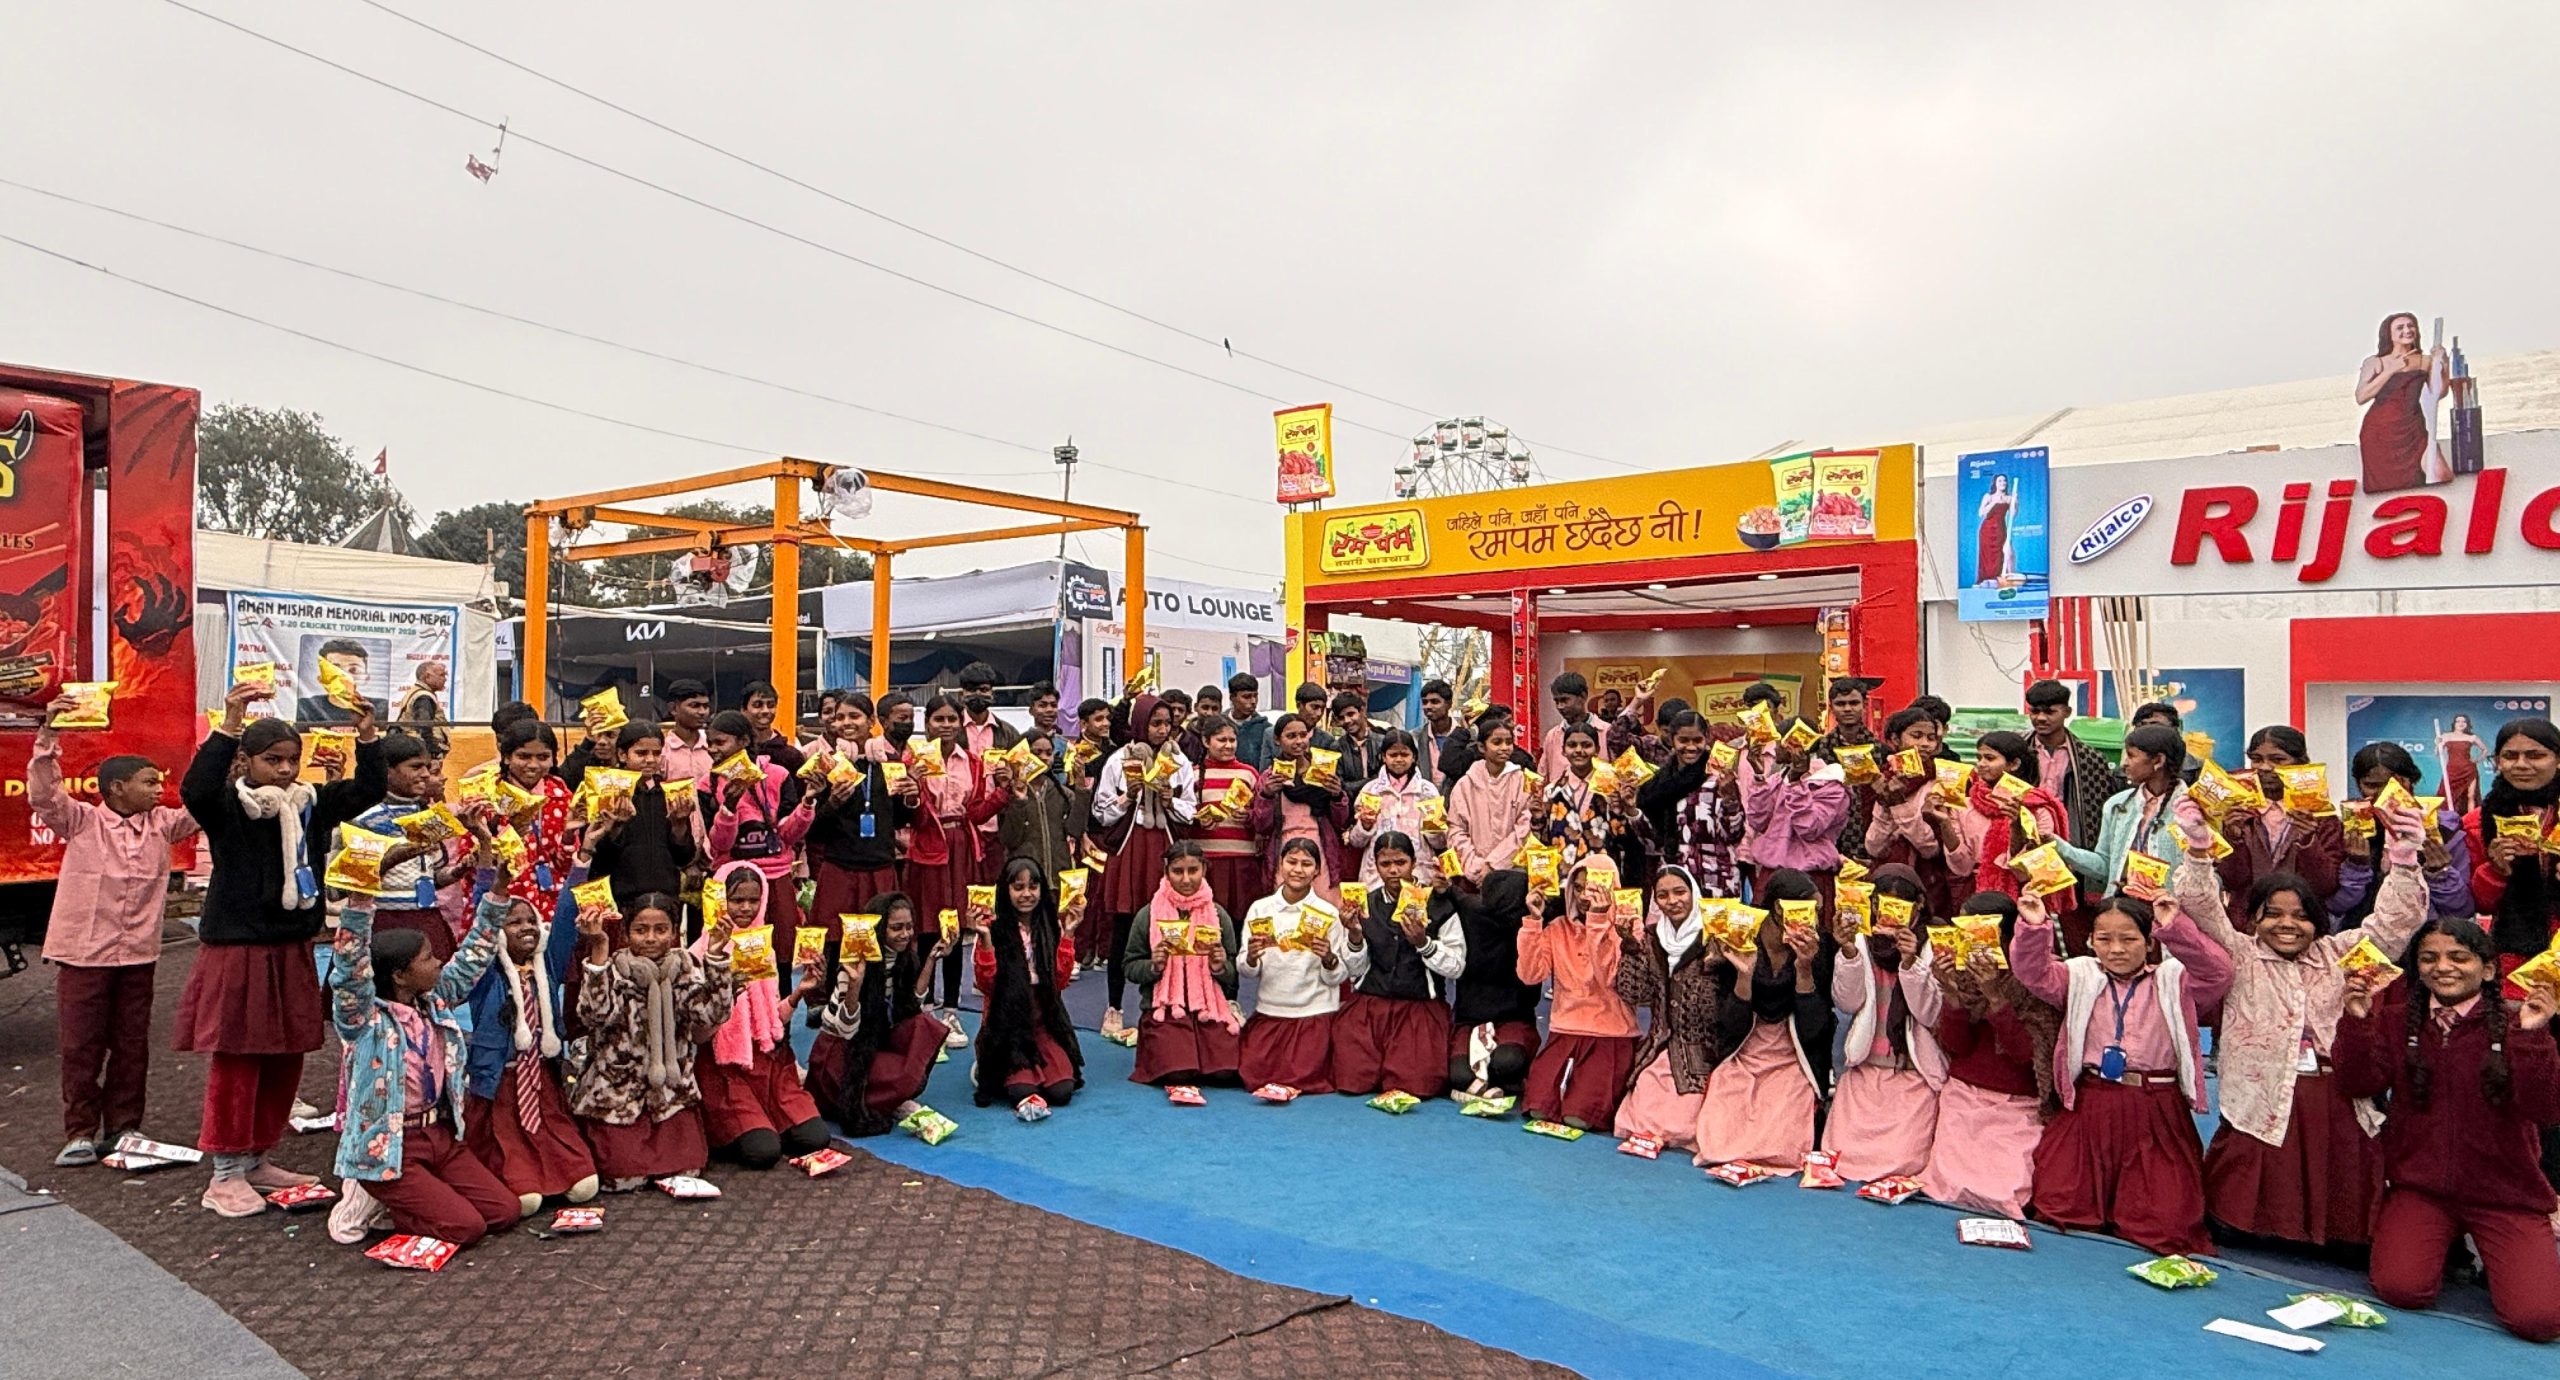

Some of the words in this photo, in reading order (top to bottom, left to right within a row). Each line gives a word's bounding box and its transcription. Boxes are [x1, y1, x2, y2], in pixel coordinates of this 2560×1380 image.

[2080, 502, 2143, 553] Rijalco
[238, 600, 274, 615] AMAN
[277, 603, 323, 619] MISHRA
[326, 607, 386, 623] MEMORIAL
[389, 612, 452, 626] INDO-NEPAL
[1188, 595, 1274, 622] LOUNGE
[300, 621, 337, 631] CRICKET
[339, 623, 395, 635] TOURNAMENT
[238, 643, 267, 653] PATNA
